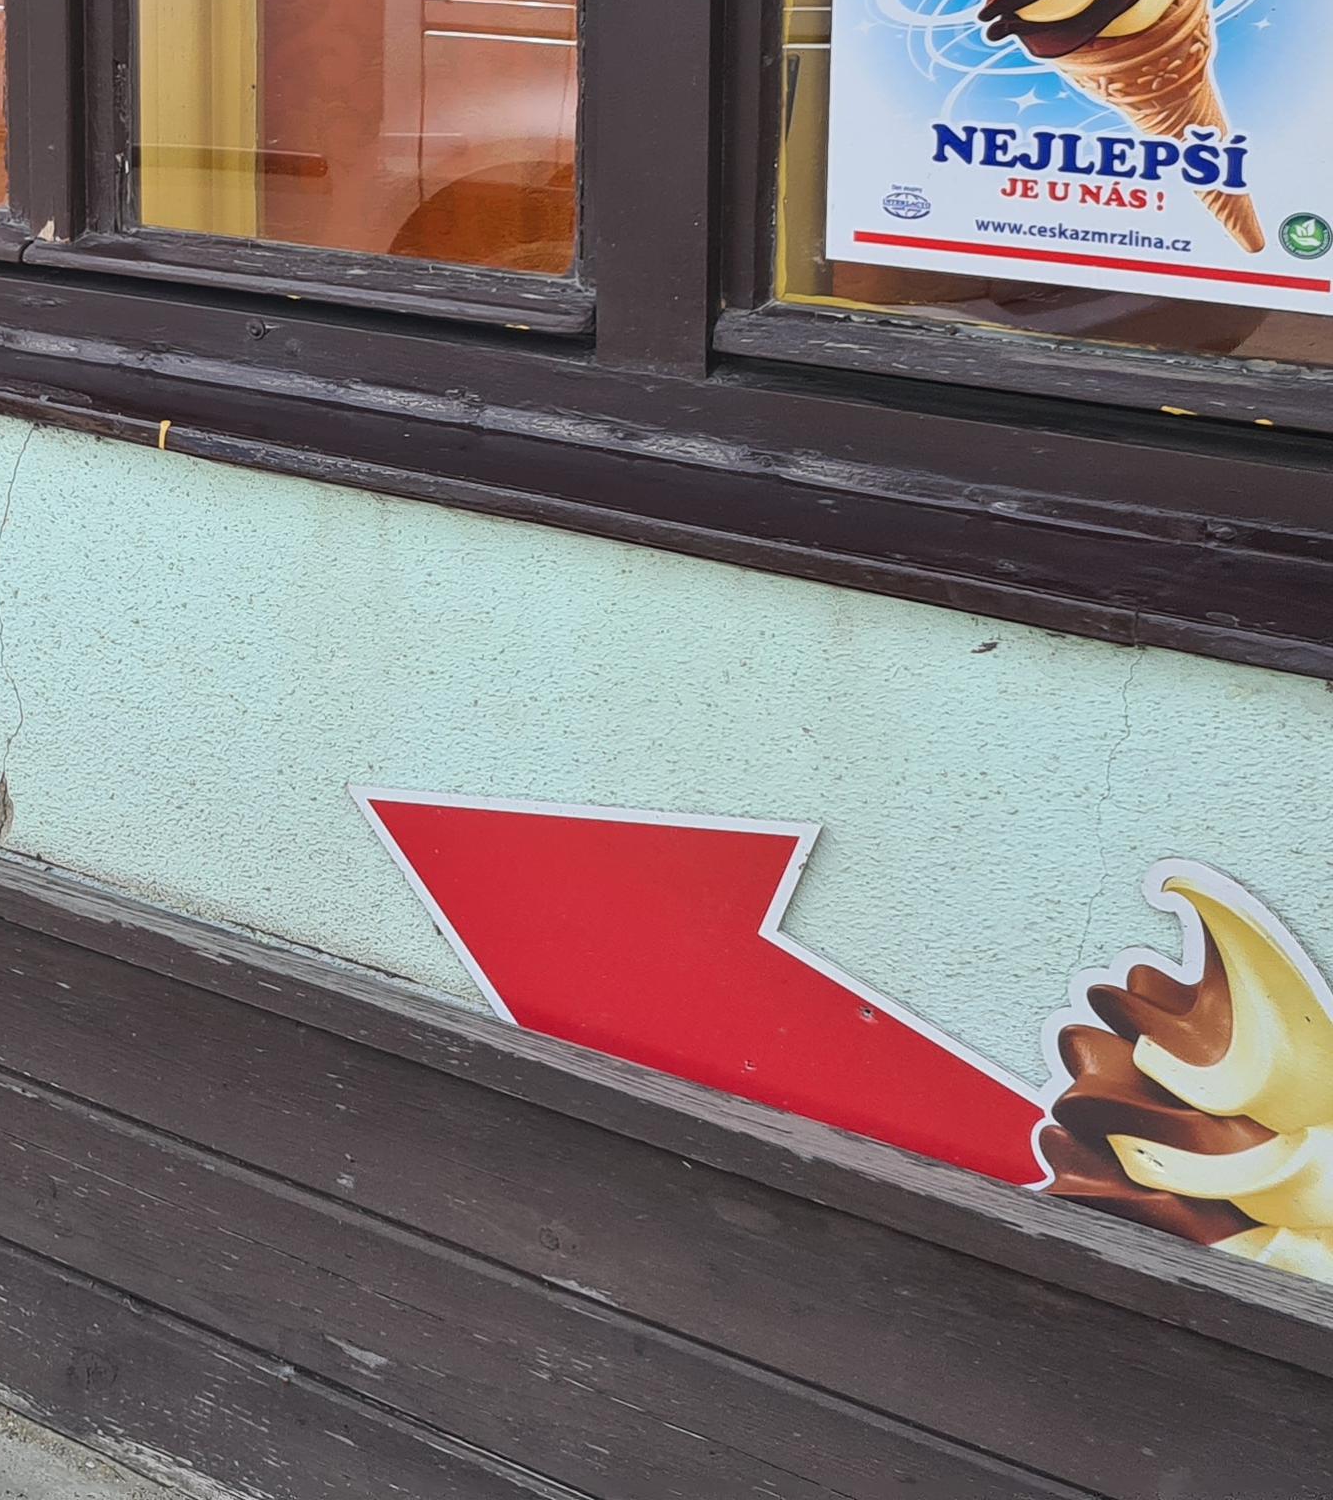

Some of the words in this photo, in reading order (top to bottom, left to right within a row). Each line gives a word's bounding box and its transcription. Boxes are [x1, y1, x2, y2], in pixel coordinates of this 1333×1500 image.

[932, 123, 1248, 189] NEJLEPŠÍ
[1000, 177, 1039, 199] JE
[1047, 181, 1070, 202] U
[1079, 182, 1148, 211] NÁS
[975, 218, 1192, 252] www.ceskazmrzlina.cz
